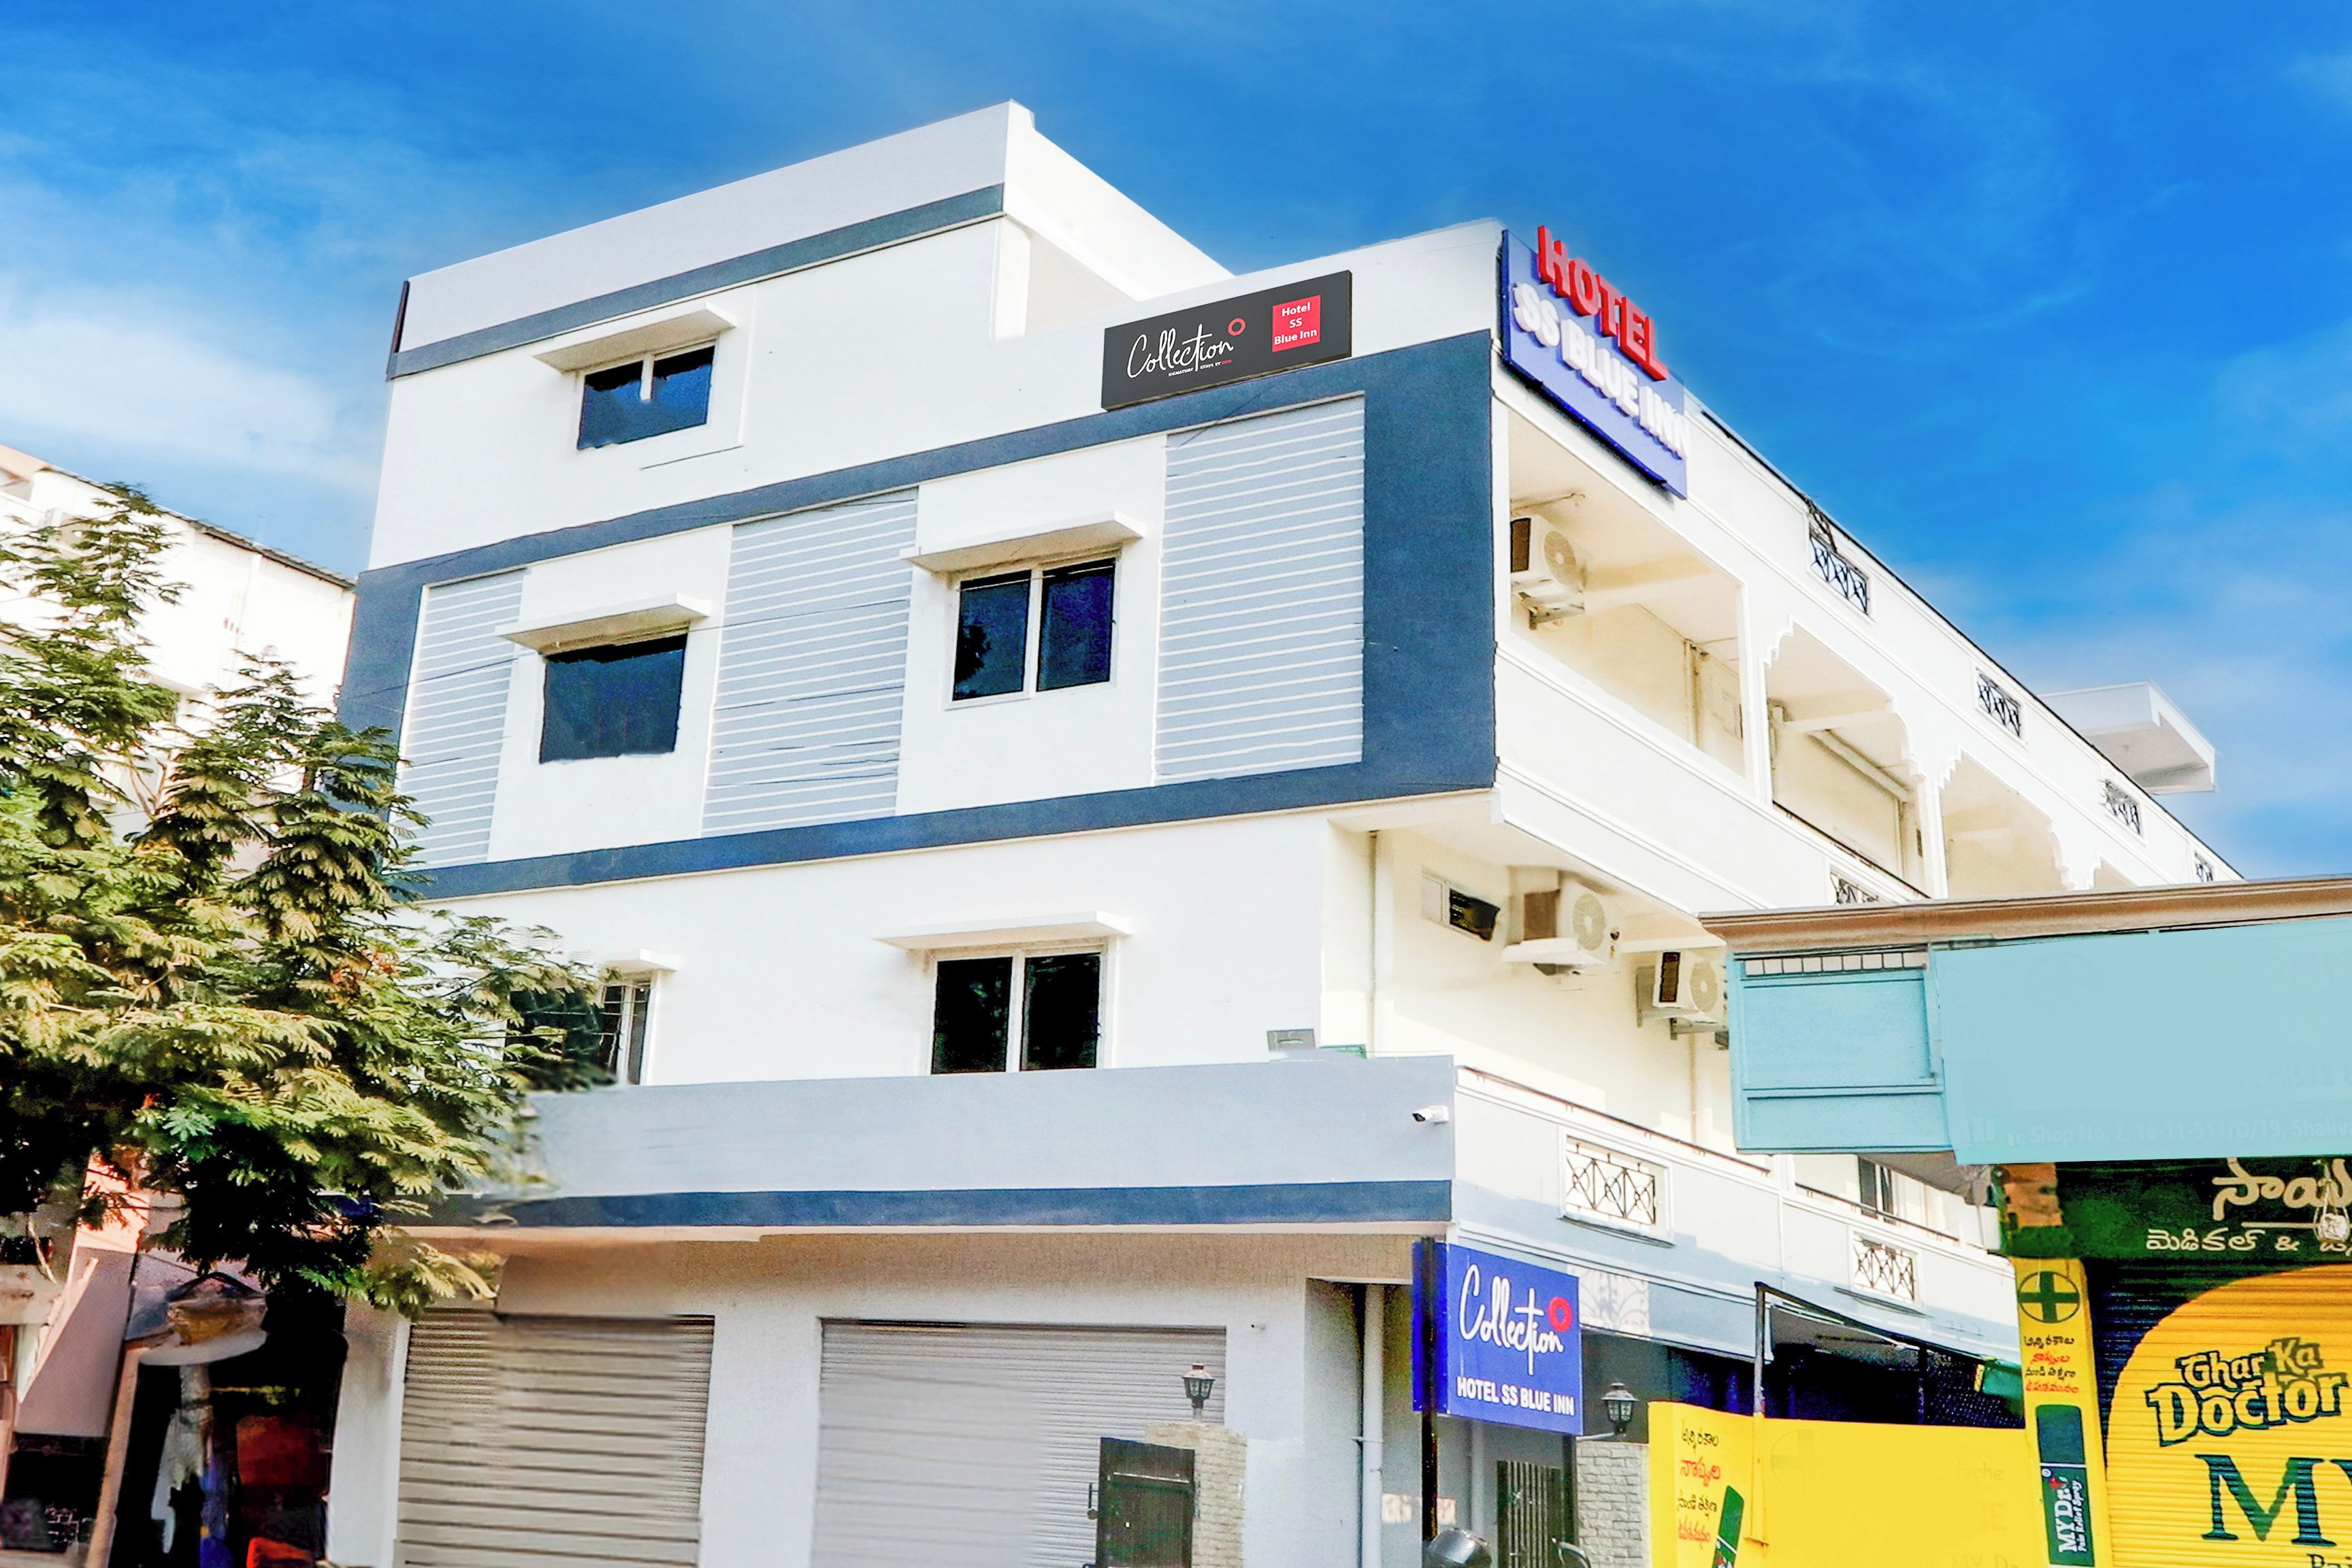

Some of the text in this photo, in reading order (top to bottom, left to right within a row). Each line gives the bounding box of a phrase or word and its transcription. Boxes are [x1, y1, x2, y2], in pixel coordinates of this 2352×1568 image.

[1281, 301, 1311, 317] Hotel
[1289, 317, 1303, 329] SS
[1537, 225, 1669, 380] HOTEL
[1127, 323, 1234, 378] Collection
[1274, 329, 1318, 345] Blue Inn
[1514, 282, 1689, 459] SS BLUE INN
[2146, 1228, 2266, 1251] మెడికల్
[2274, 1236, 2300, 1252] &
[1459, 1264, 1564, 1375] Collection
[2175, 1337, 2323, 1392] Ghar Ka
[1456, 1376, 1574, 1416] HOTEL SS BLUE INN
[2144, 1372, 2349, 1447] Doctor
[2055, 1518, 2078, 1553] MY
